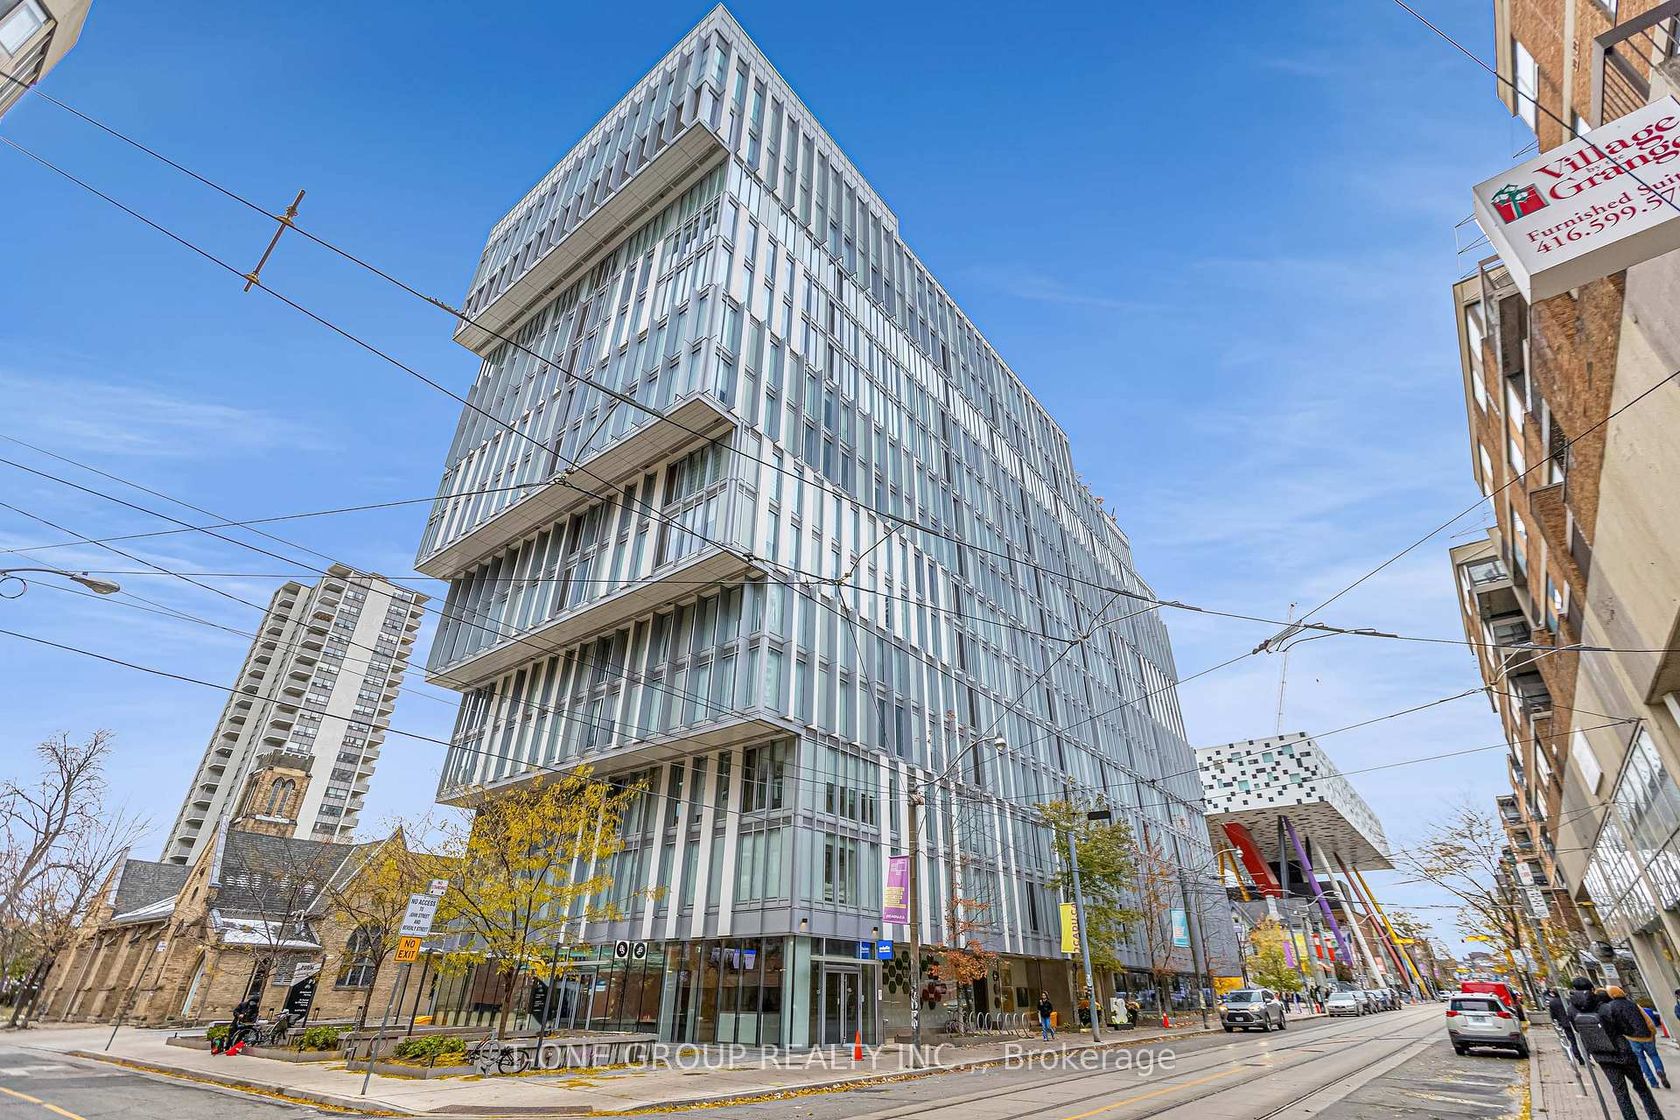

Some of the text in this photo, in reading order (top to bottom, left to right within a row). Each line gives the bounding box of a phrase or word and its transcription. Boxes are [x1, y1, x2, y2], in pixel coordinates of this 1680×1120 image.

[1533, 116, 1680, 181] Village
[1526, 192, 1633, 242] Furnished
[1537, 186, 1680, 253] 416.599.57
[419, 899, 436, 907] ACCESS
[398, 950, 416, 959] EXIT
